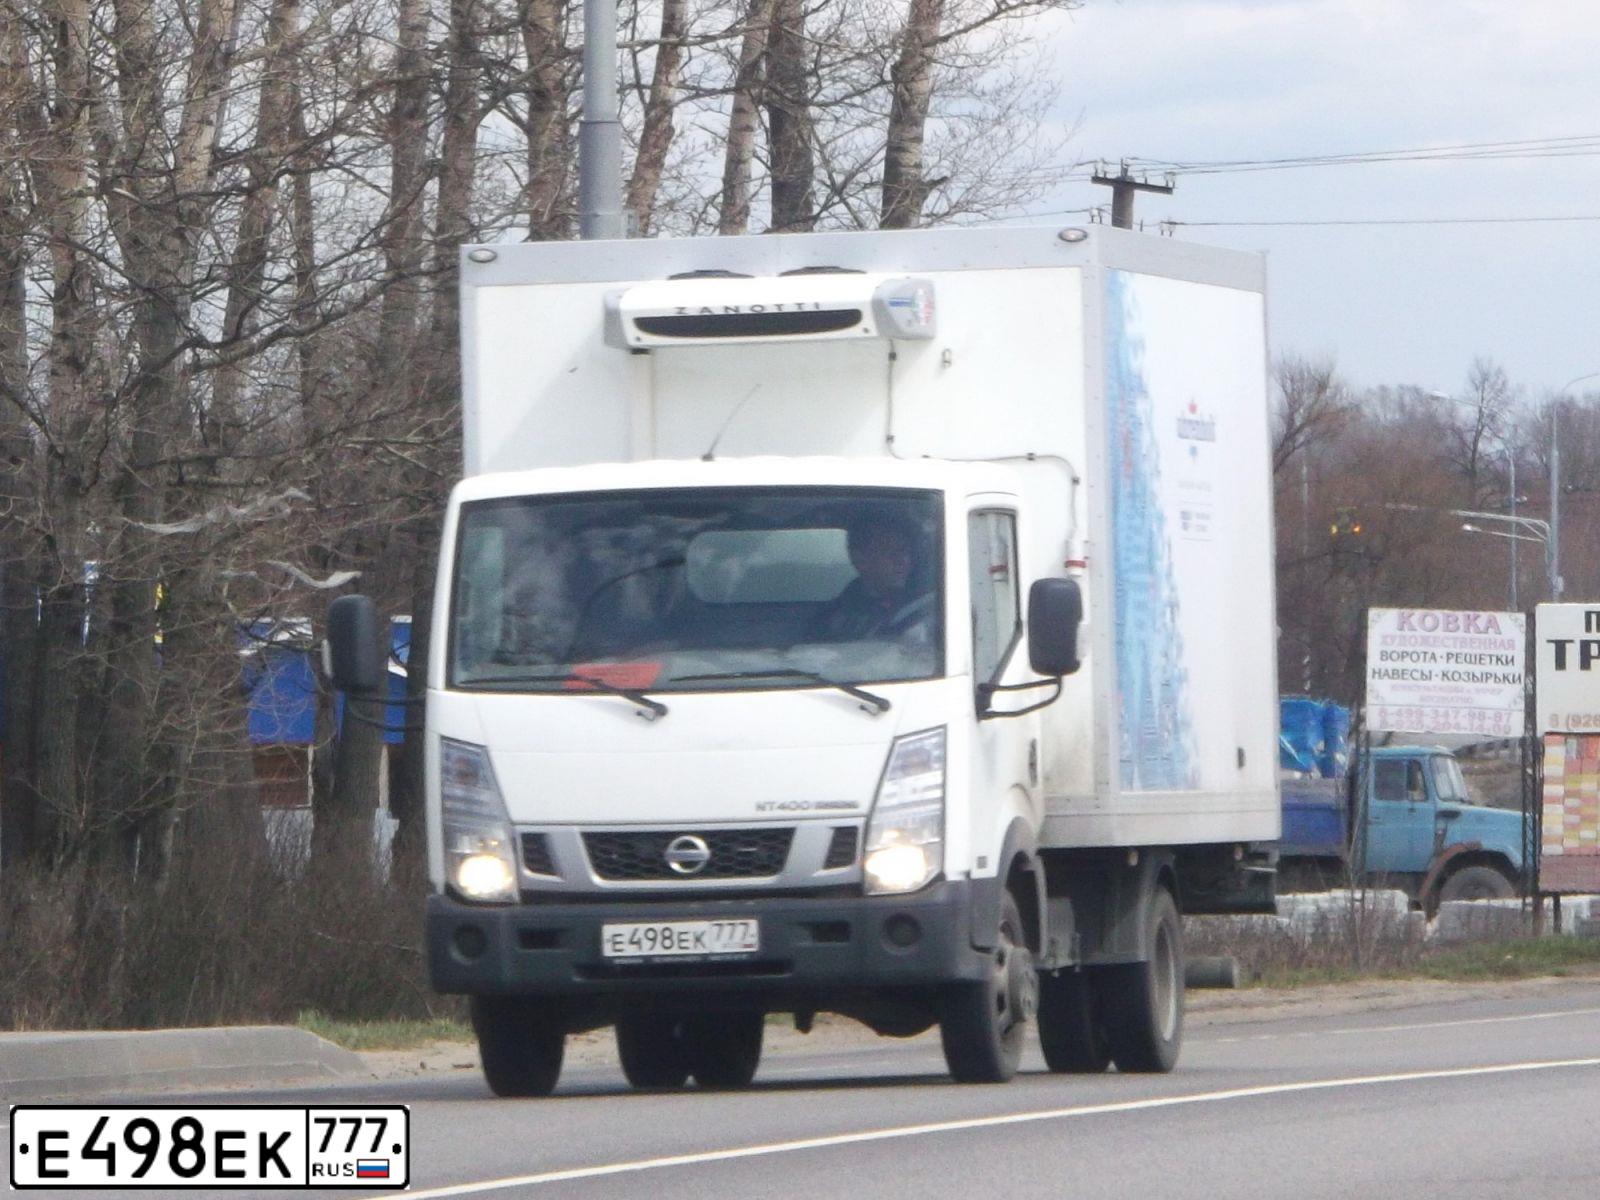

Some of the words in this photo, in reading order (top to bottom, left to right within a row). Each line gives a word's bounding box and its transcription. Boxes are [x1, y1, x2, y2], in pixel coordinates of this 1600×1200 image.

[676, 302, 820, 315] ZANOTTI
[1396, 611, 1502, 635] КОВКА
[1380, 634, 1516, 651] ХУДОЖЕСТВЕННАЯ
[1379, 650, 1438, 664] ВОРОТА
[1445, 652, 1516, 667] РЕШЕТКИ
[1371, 667, 1433, 682] НАВЕСЫ
[1441, 670, 1523, 686] КОЗЫРЬКИ
[611, 926, 707, 953] Е498ЕК
[712, 922, 750, 941] 777
